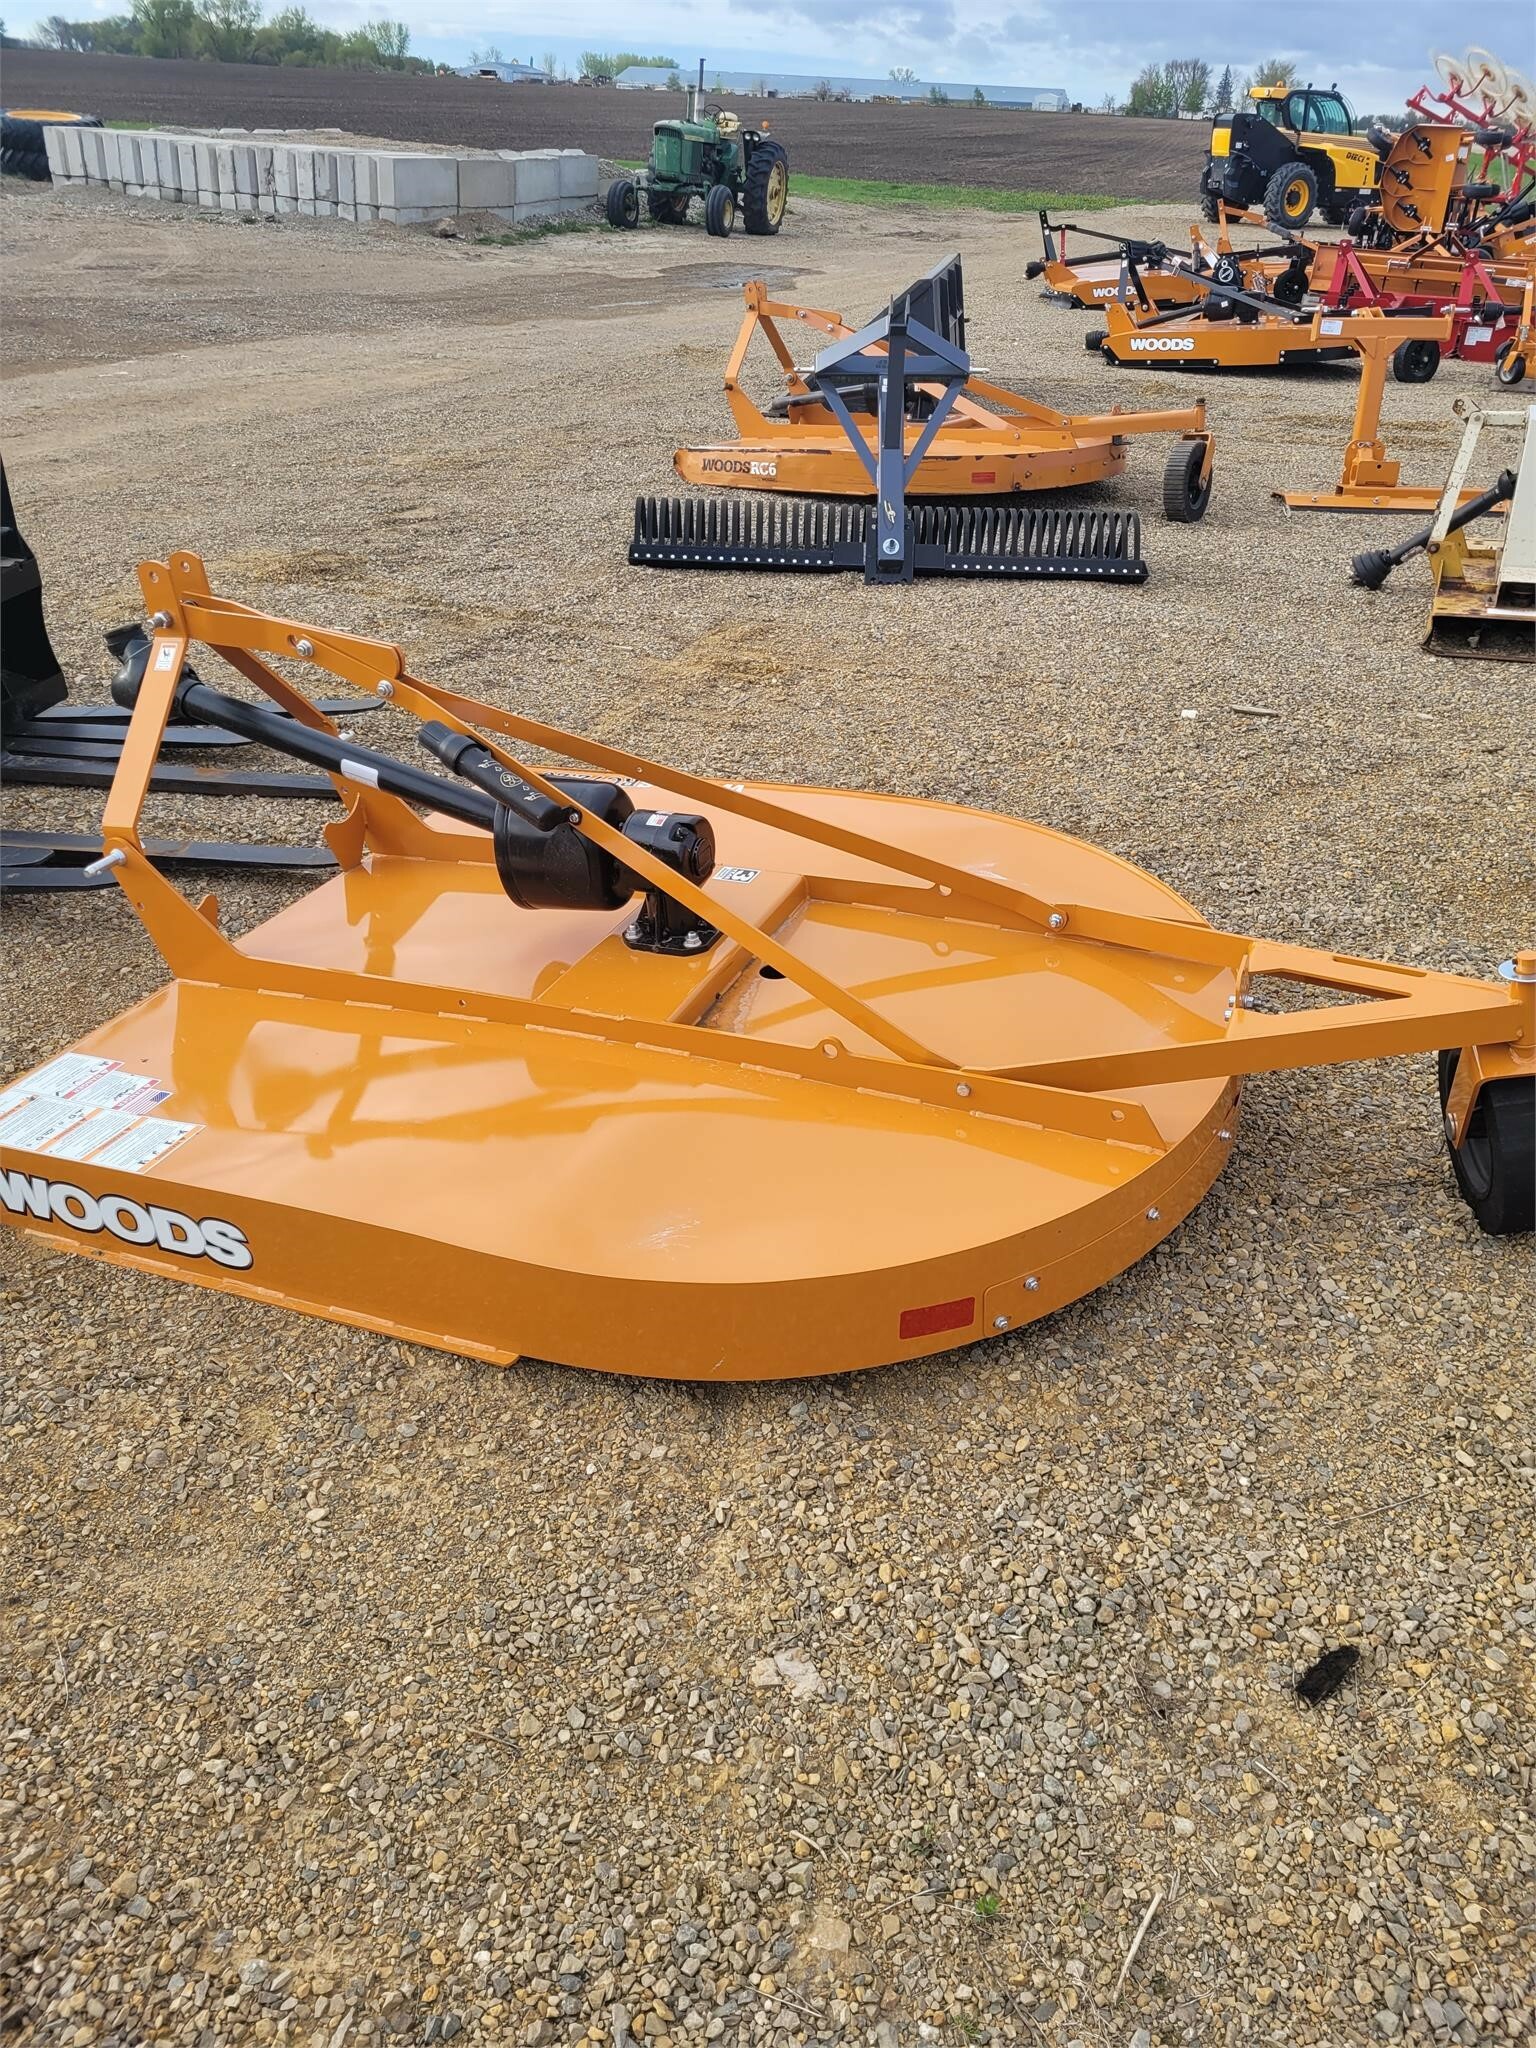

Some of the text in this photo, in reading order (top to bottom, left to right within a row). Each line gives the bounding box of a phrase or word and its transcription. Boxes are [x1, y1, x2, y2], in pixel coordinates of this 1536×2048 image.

[1345, 151, 1366, 163] DIECI
[1130, 337, 1196, 352] WOODS
[0, 1167, 254, 1271] WOODS
